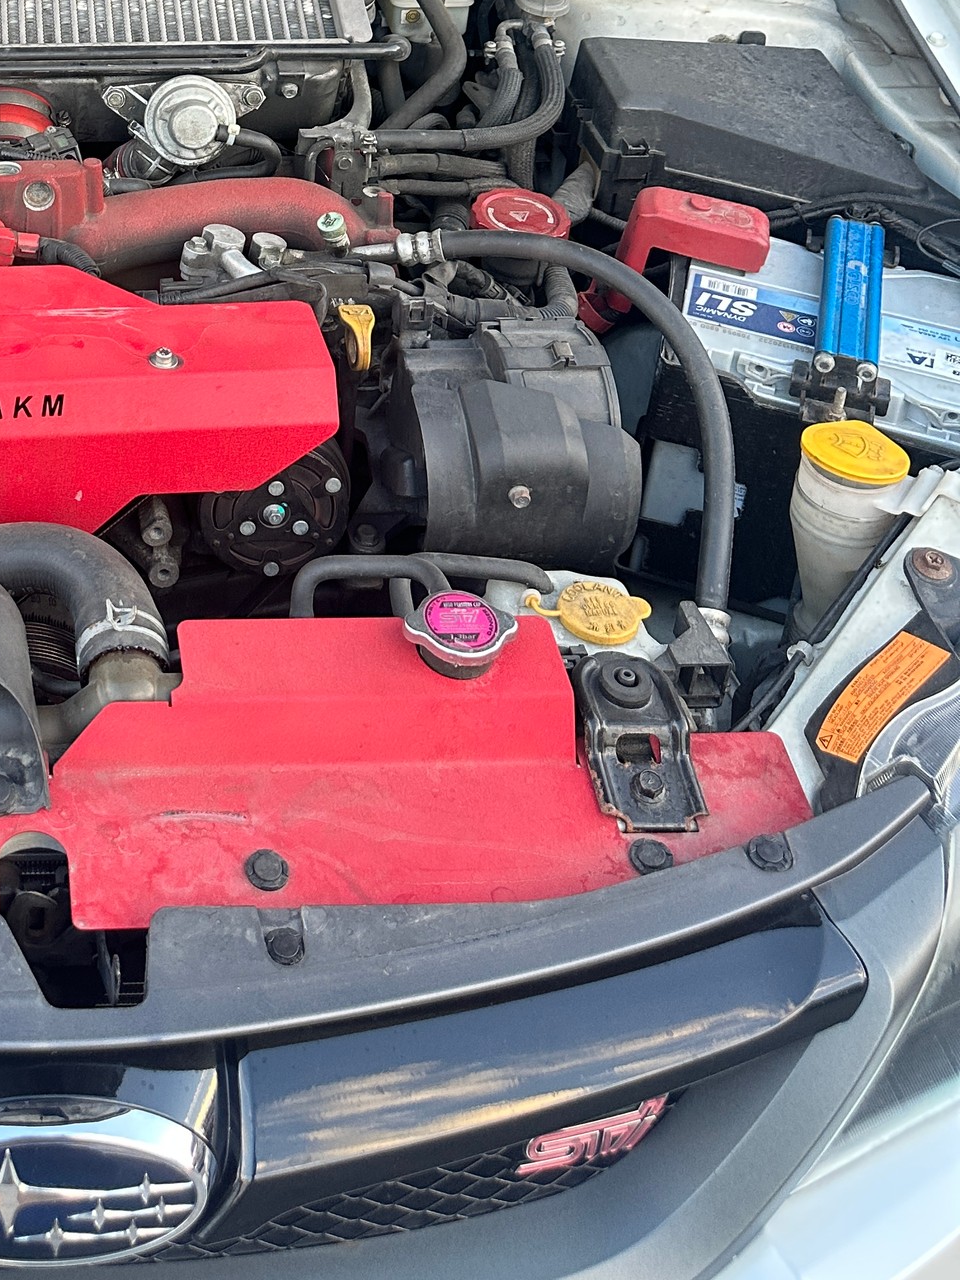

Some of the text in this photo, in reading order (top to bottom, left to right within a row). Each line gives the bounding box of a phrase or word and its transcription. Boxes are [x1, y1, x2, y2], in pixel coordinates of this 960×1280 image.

[695, 292, 758, 317] SLI
[695, 305, 747, 322] DYNAMIC
[561, 582, 624, 602] COOLANT
